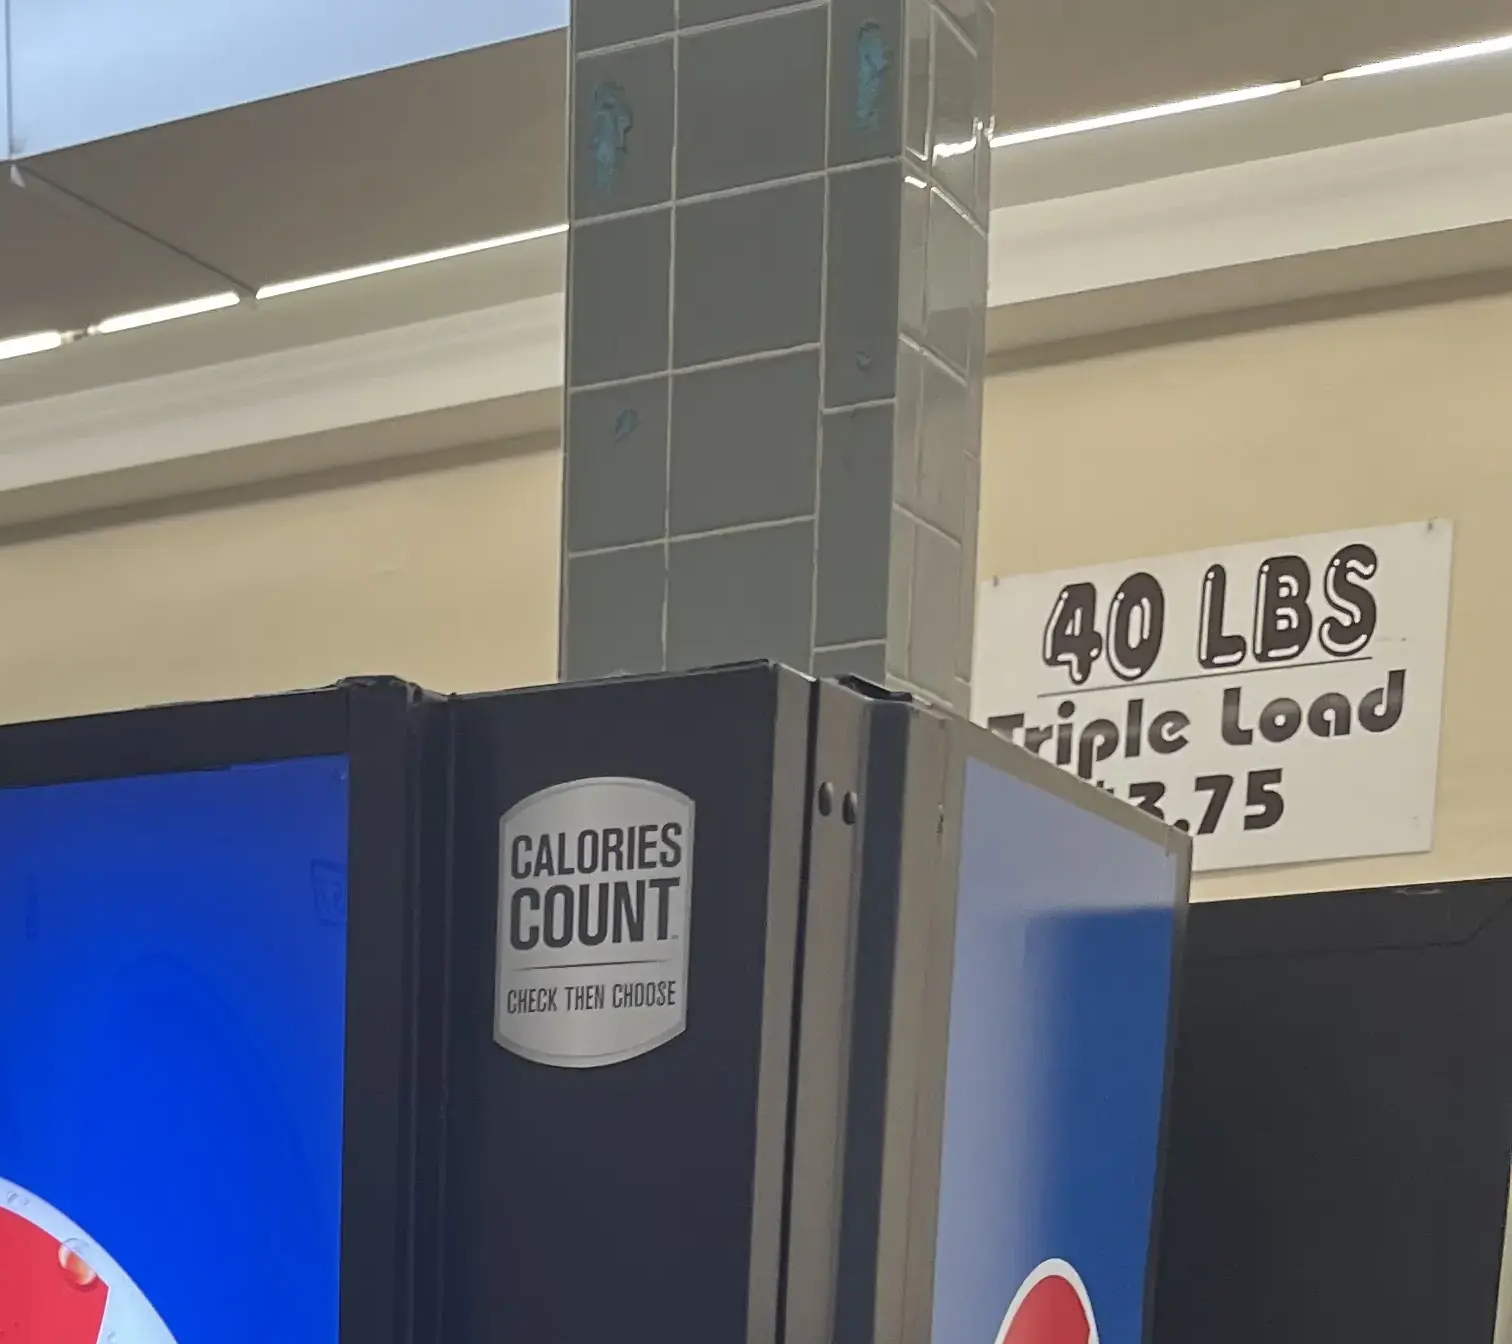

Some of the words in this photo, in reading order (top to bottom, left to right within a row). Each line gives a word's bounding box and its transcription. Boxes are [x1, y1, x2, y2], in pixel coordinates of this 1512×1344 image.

[1042, 572, 1166, 685] 40
[1197, 543, 1378, 670] LBS
[1221, 669, 1406, 747] Load
[1096, 768, 1285, 836] 3.75
[511, 822, 682, 879] CALORIES
[510, 877, 680, 950] COUNT
[507, 985, 558, 1014] CHECK
[565, 984, 605, 1012] THEN
[611, 980, 677, 1008] CHOOSE
